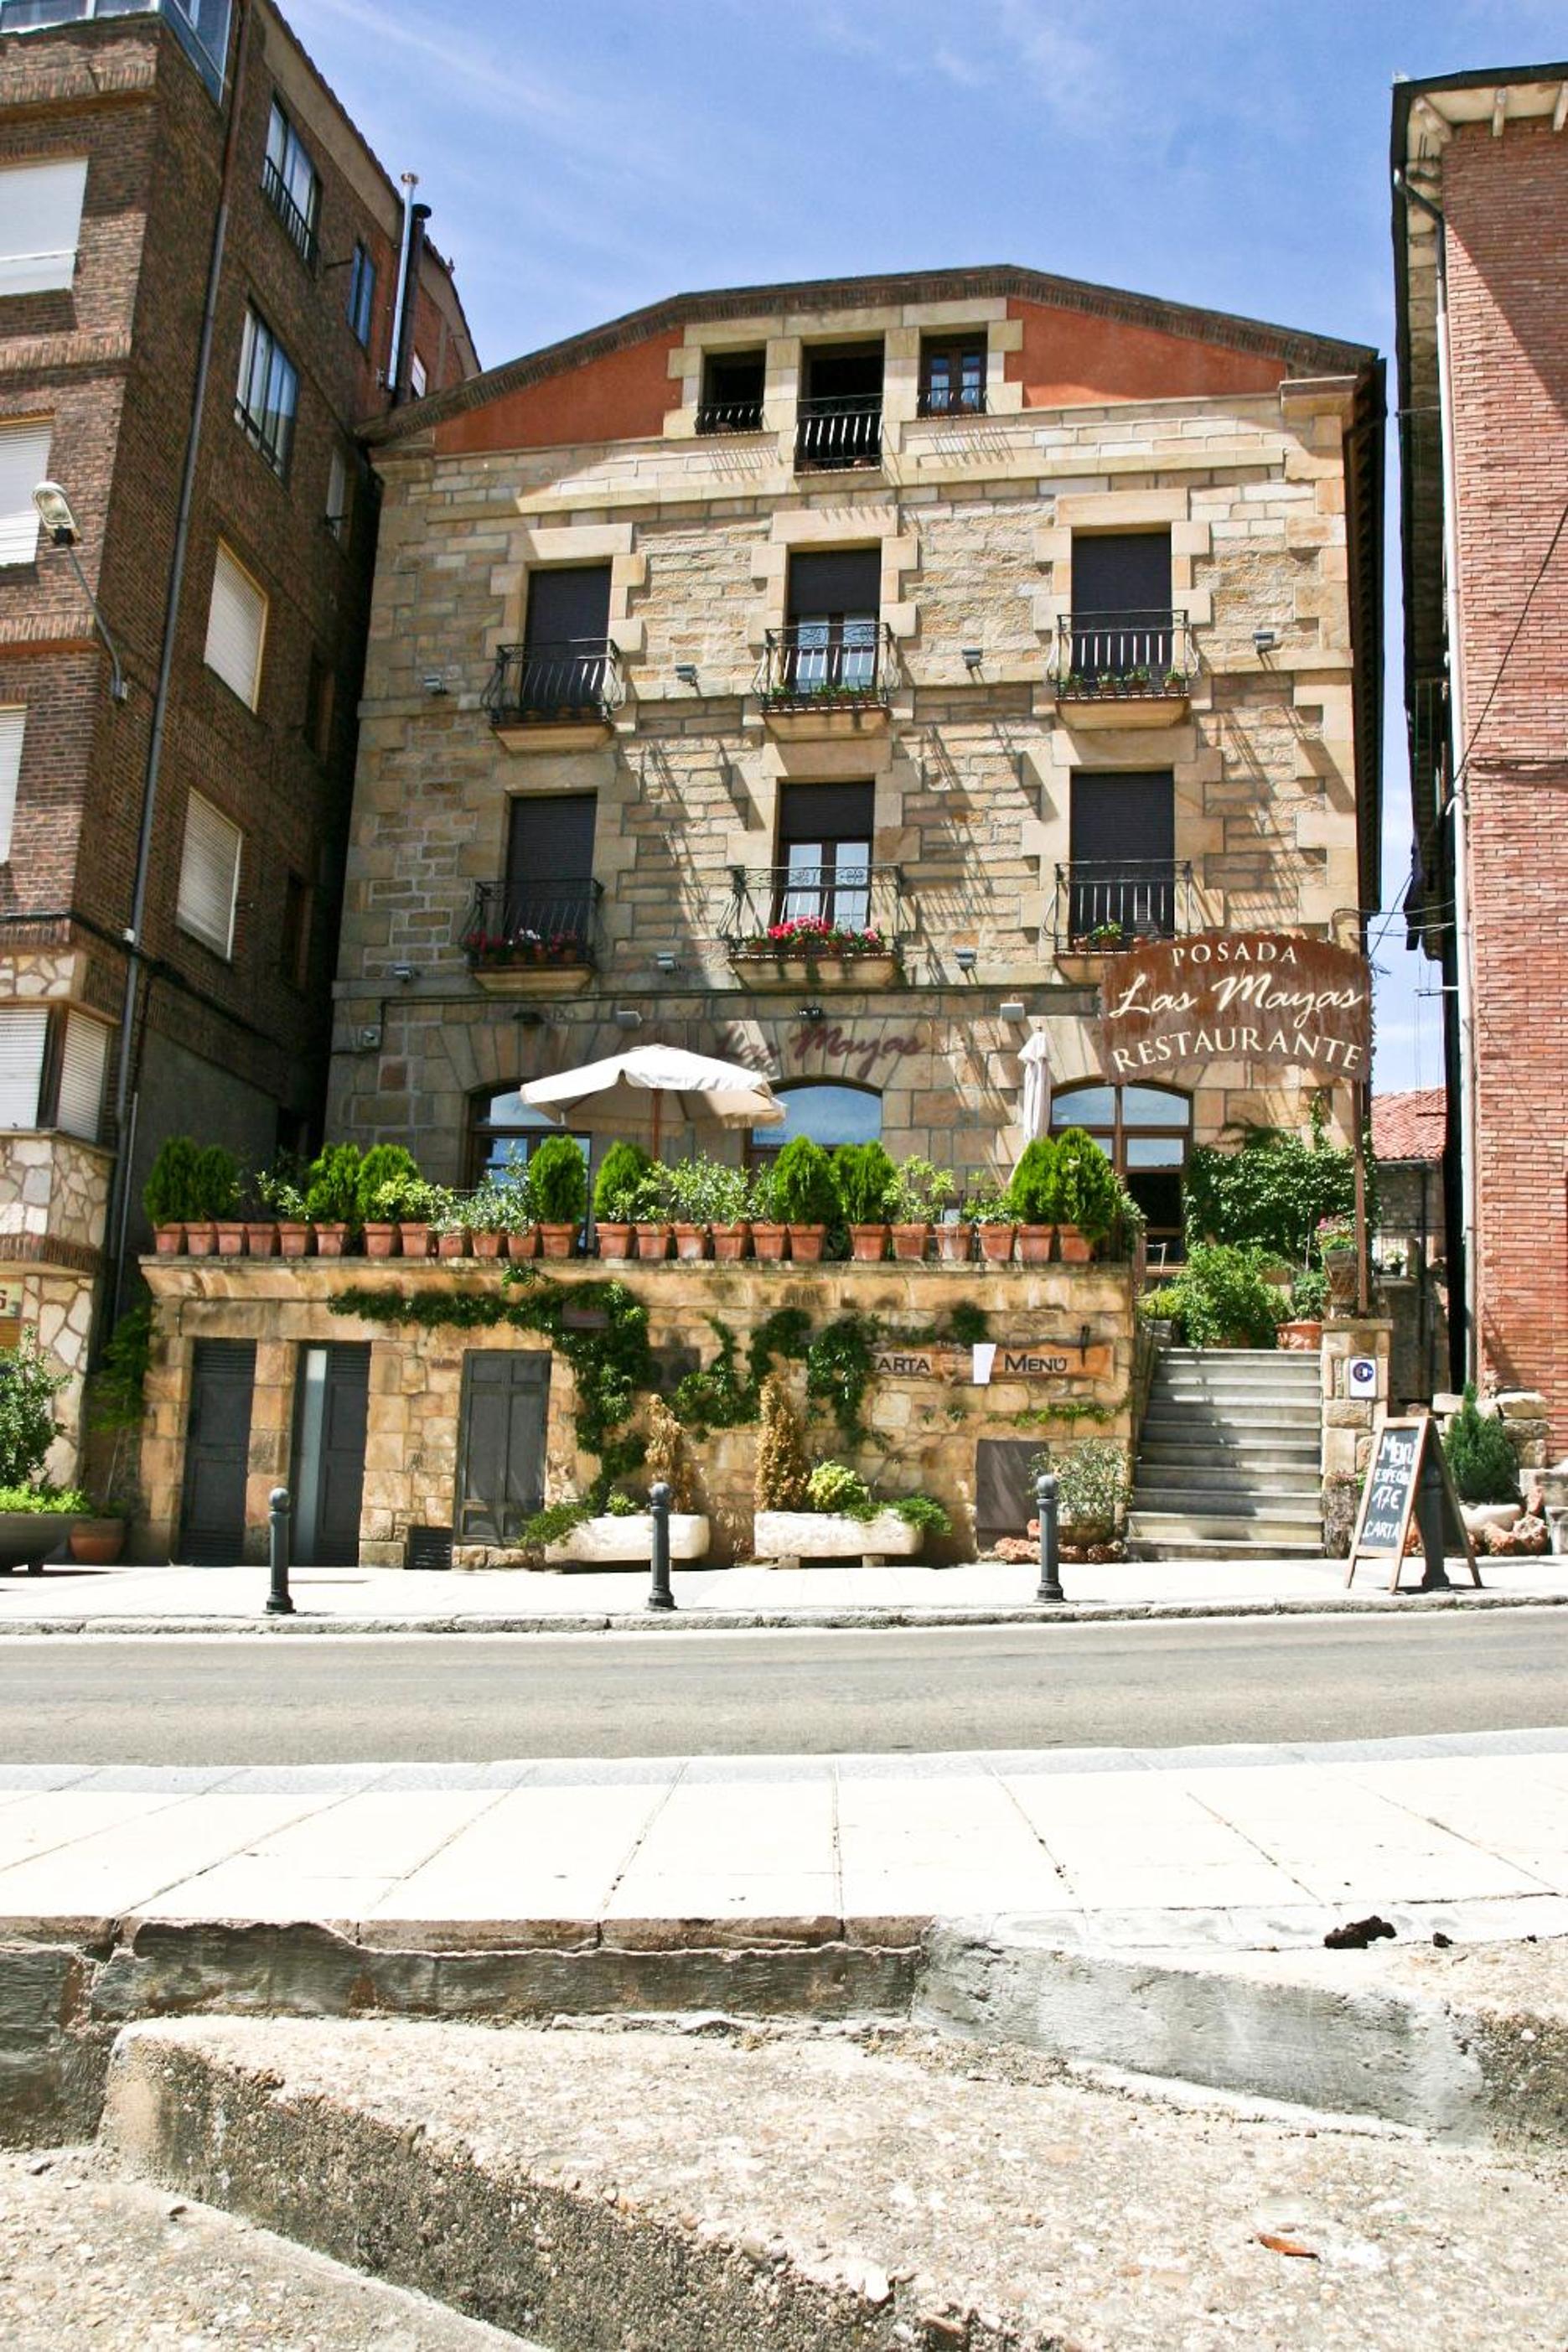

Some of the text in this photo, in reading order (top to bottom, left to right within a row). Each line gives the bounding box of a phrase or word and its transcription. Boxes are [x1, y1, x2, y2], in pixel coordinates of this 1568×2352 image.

[1172, 941, 1298, 966] POSADA
[1109, 970, 1364, 1028] Las Mayas
[789, 1025, 925, 1080] Mayas
[1112, 1027, 1363, 1072] RESTAURANTE
[1371, 1486, 1402, 1511] 17€
[1362, 1520, 1401, 1540] CARTA
